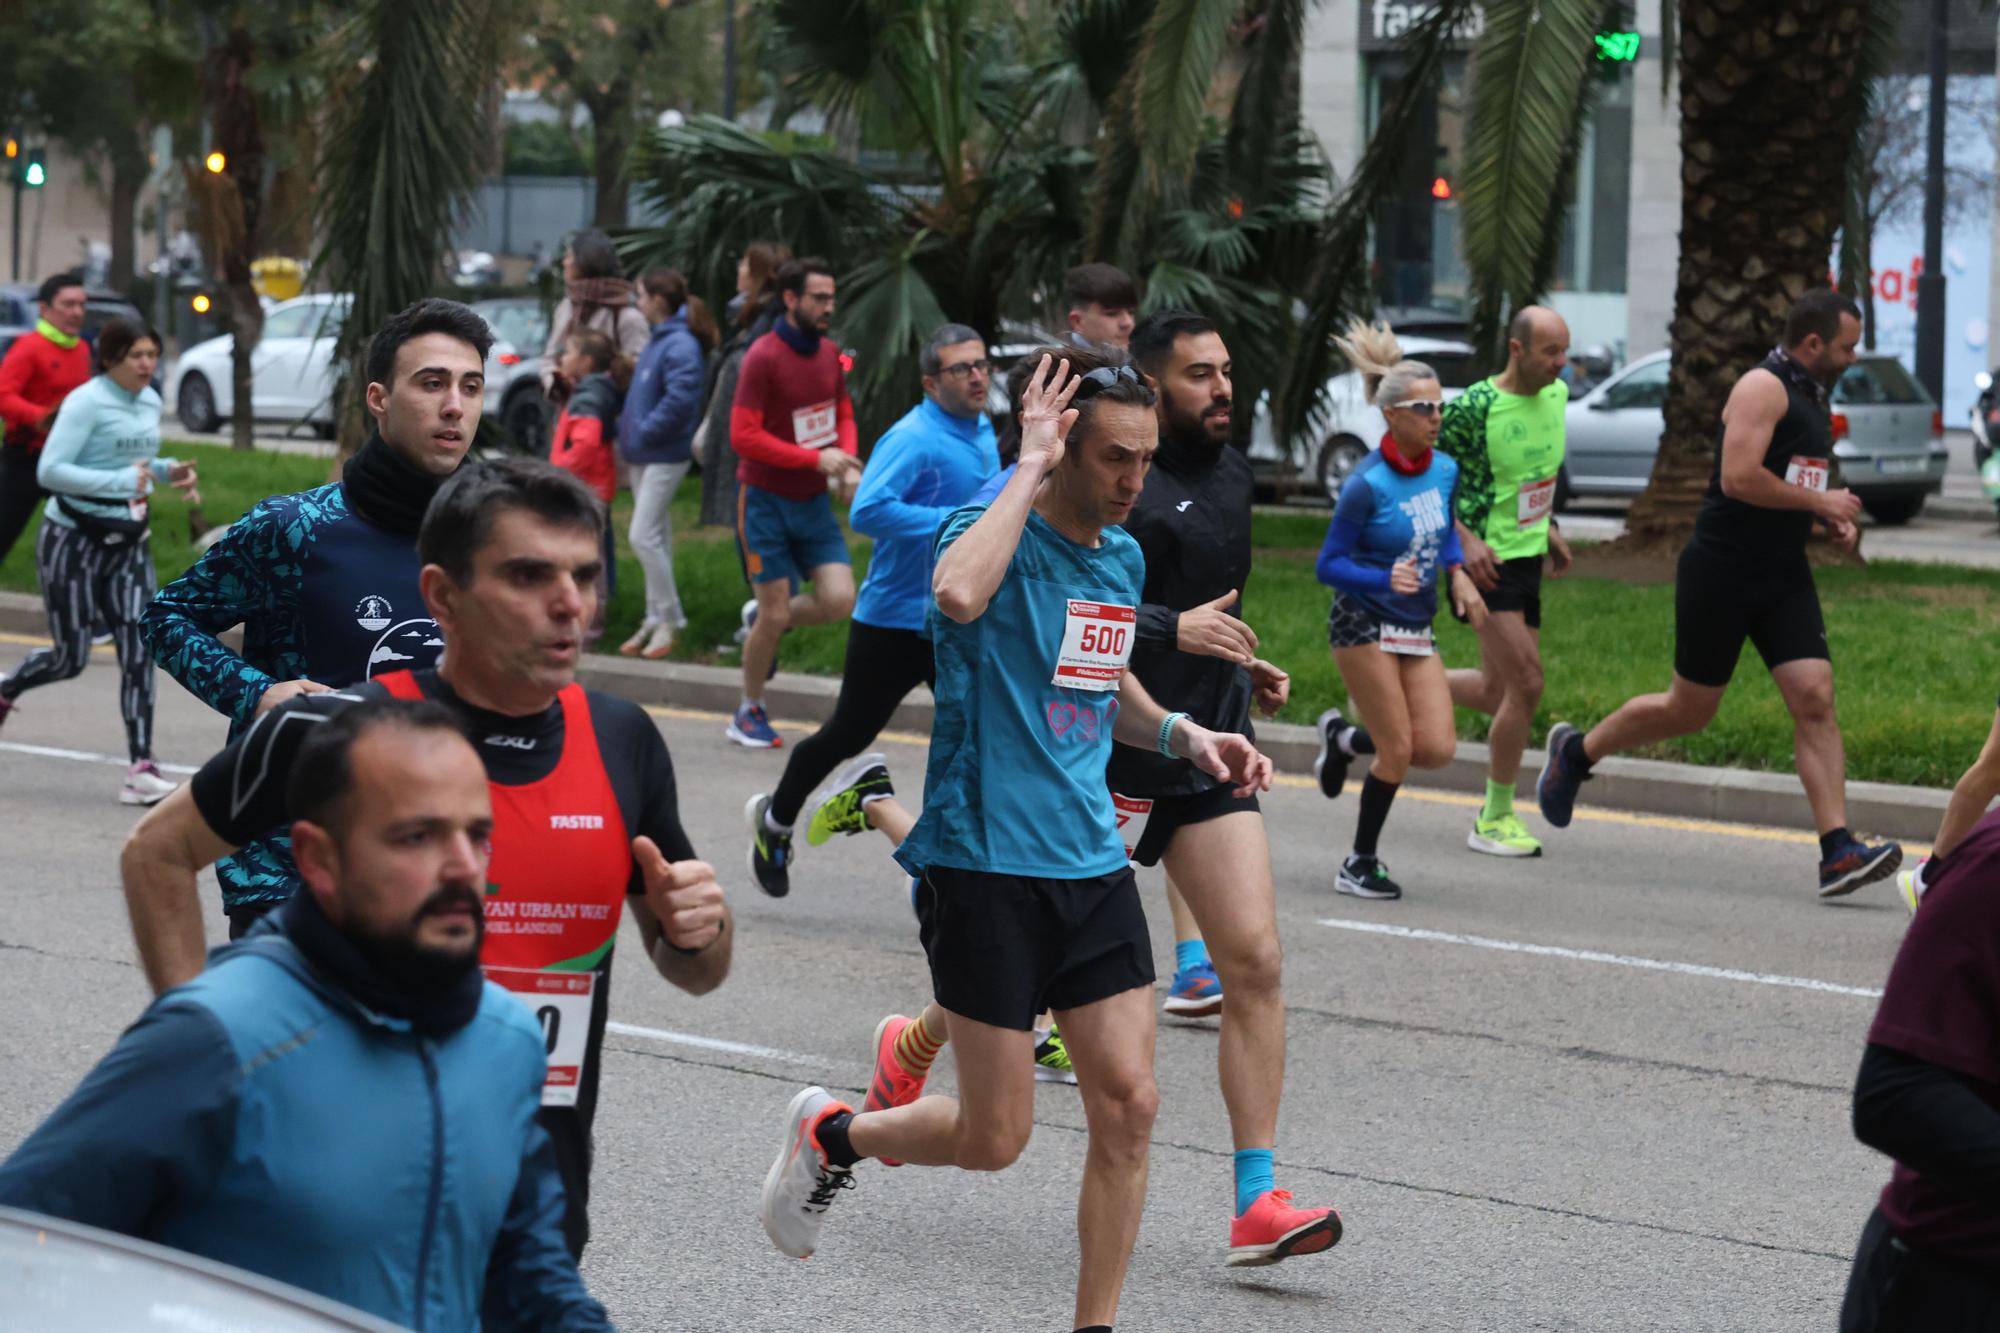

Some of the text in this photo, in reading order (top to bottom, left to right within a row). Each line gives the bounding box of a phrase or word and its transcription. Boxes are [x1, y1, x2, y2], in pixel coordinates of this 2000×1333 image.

[1080, 624, 1126, 655] 500
[550, 815, 604, 829] FASTER
[520, 903, 577, 919] URBAN
[580, 904, 611, 920] WAY
